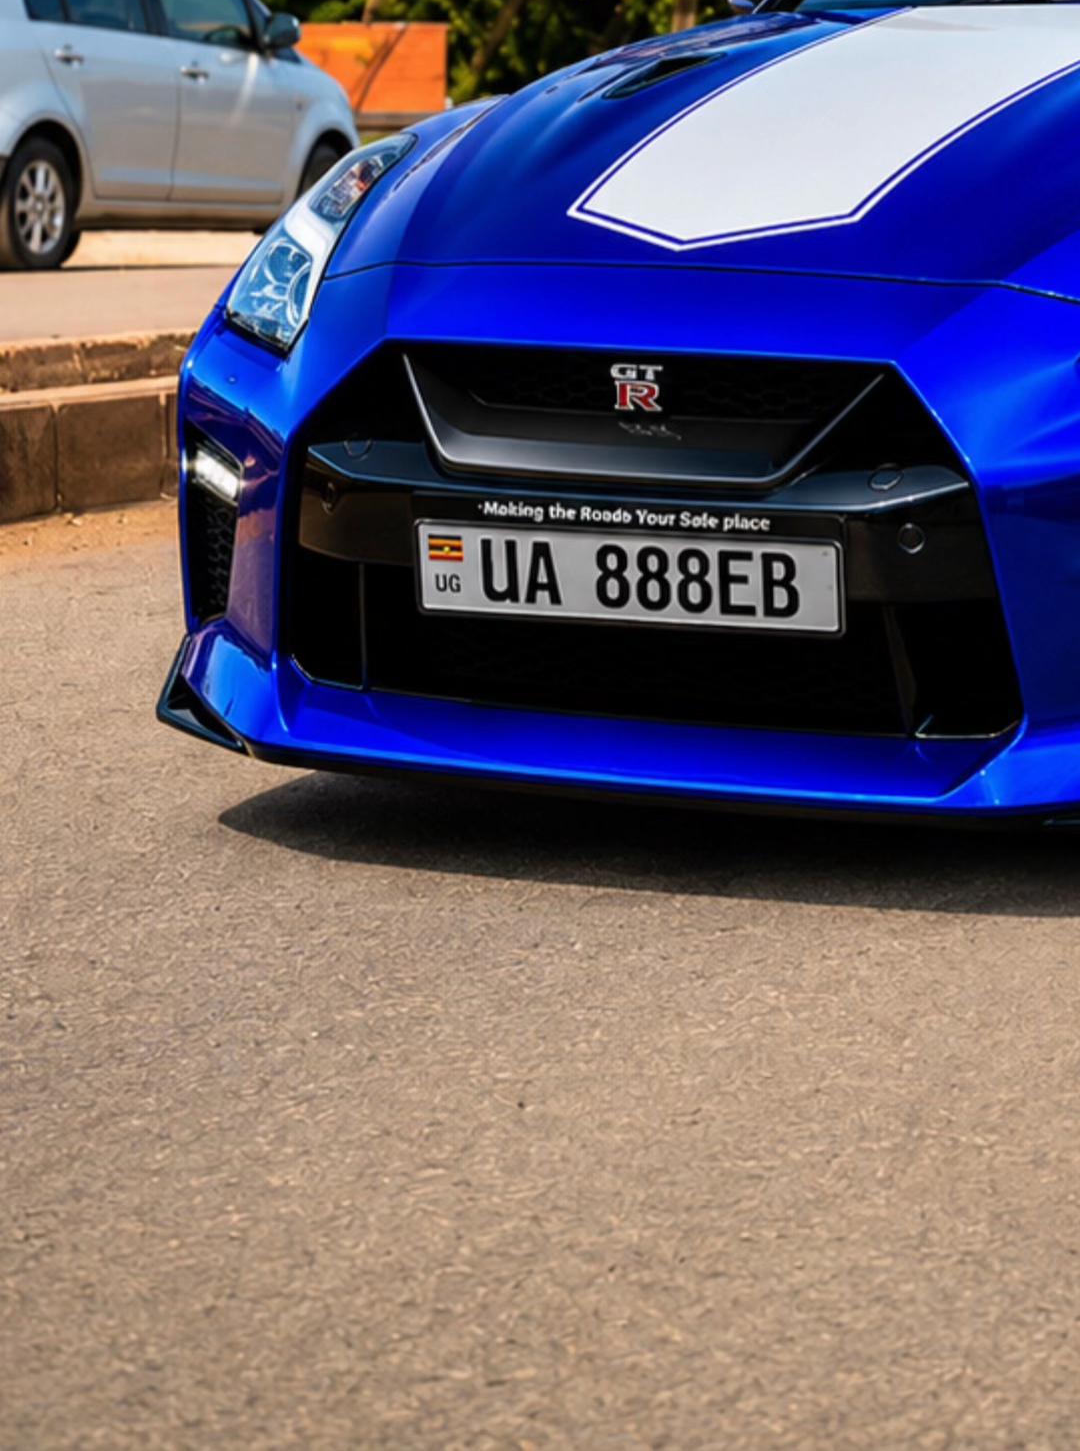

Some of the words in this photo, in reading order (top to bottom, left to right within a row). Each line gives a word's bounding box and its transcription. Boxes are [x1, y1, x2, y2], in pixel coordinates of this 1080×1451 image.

[610, 363, 663, 380] GT
[614, 379, 663, 411] R
[548, 502, 577, 520] the
[635, 509, 676, 526] Your
[723, 513, 770, 532] place
[435, 574, 461, 593] UG
[480, 538, 562, 606] UA
[595, 543, 801, 619] 888EB
